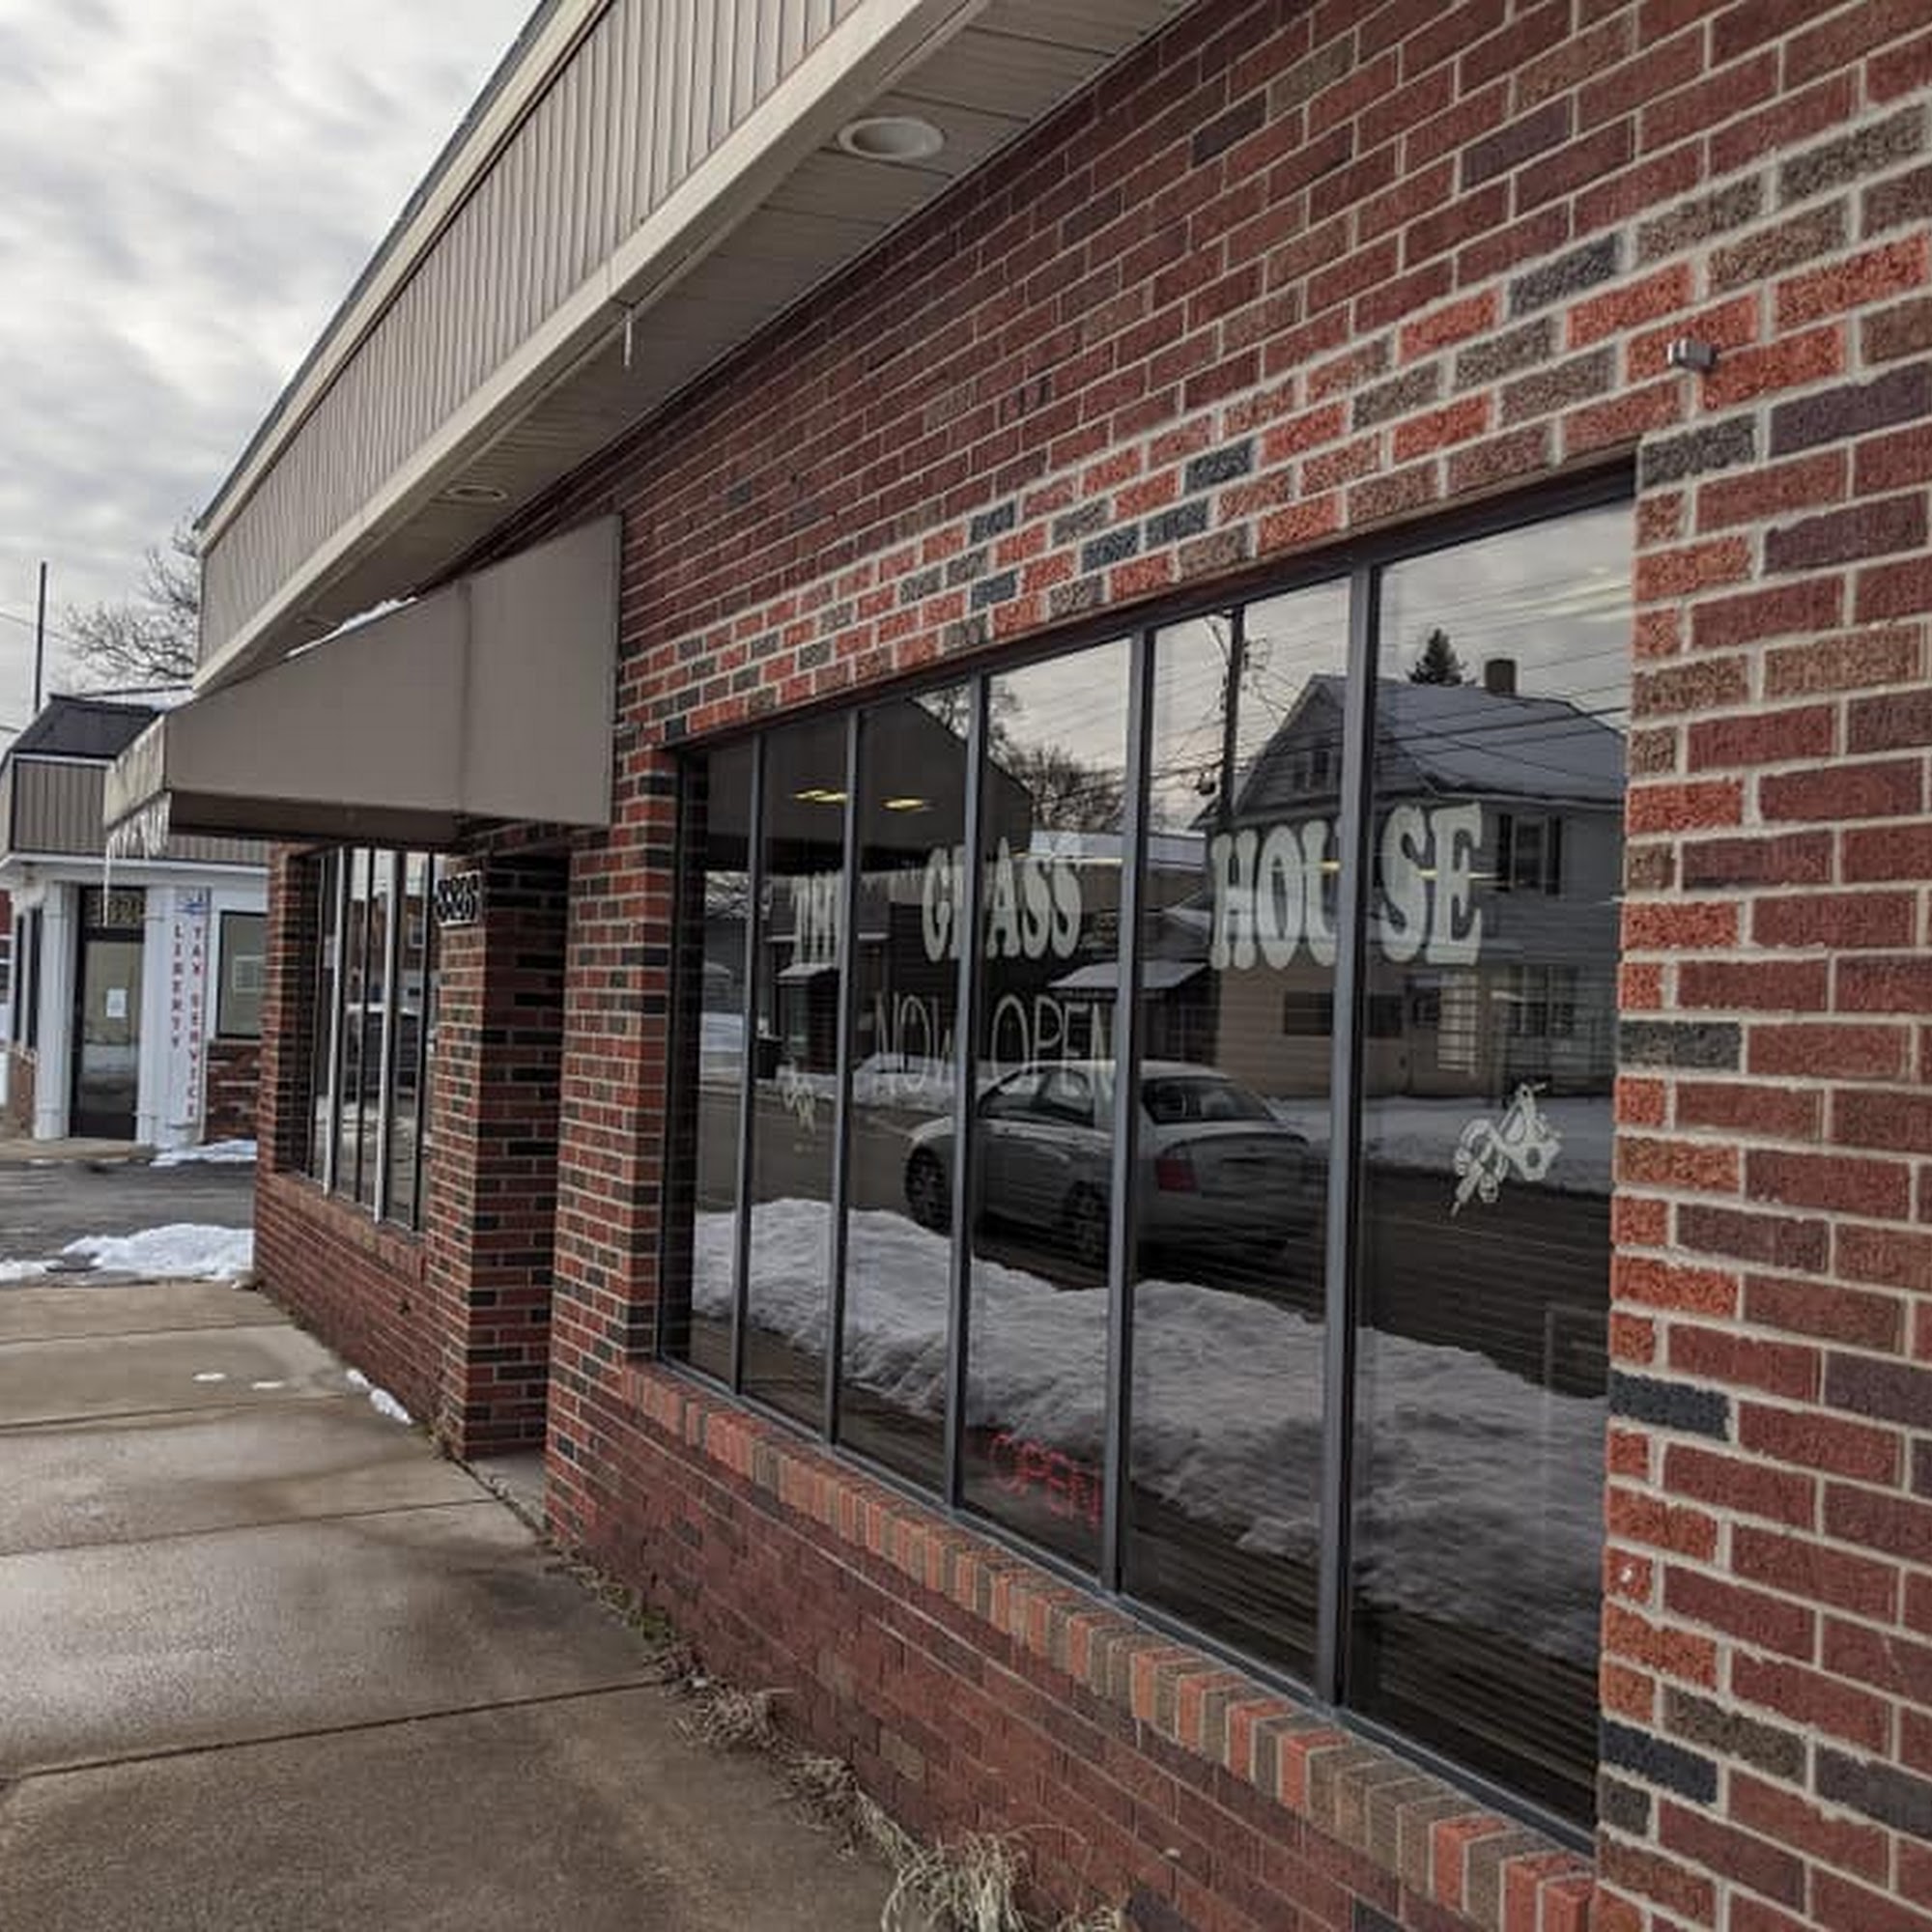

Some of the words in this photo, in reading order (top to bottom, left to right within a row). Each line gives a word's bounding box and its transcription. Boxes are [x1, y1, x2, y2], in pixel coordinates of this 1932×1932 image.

[1210, 804, 1483, 970] HOUSE
[171, 923, 185, 1049] LIBERTY
[191, 925, 203, 976] TAX
[186, 991, 201, 1118] SERVICE
[991, 994, 1116, 1101] OPEN
[988, 1433, 1101, 1529] OPEN
